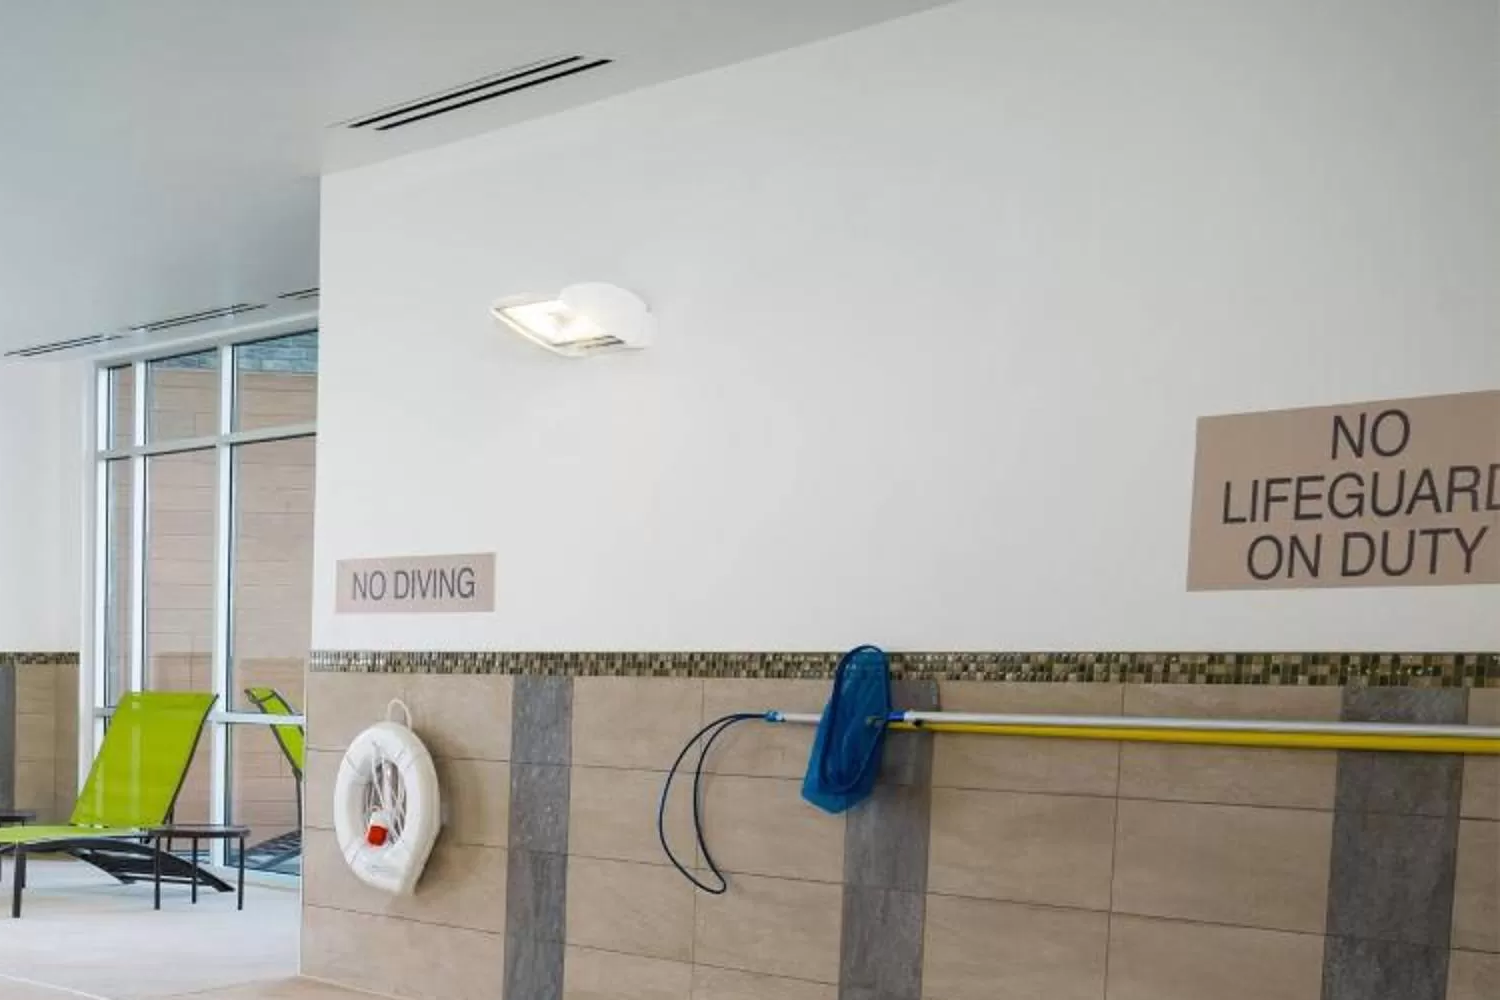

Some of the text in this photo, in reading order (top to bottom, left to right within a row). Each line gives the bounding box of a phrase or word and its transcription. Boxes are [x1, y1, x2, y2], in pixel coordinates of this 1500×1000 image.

[1330, 408, 1411, 460] NO
[1246, 525, 1489, 581] ON DUTY
[352, 567, 476, 601] NO DIVING
